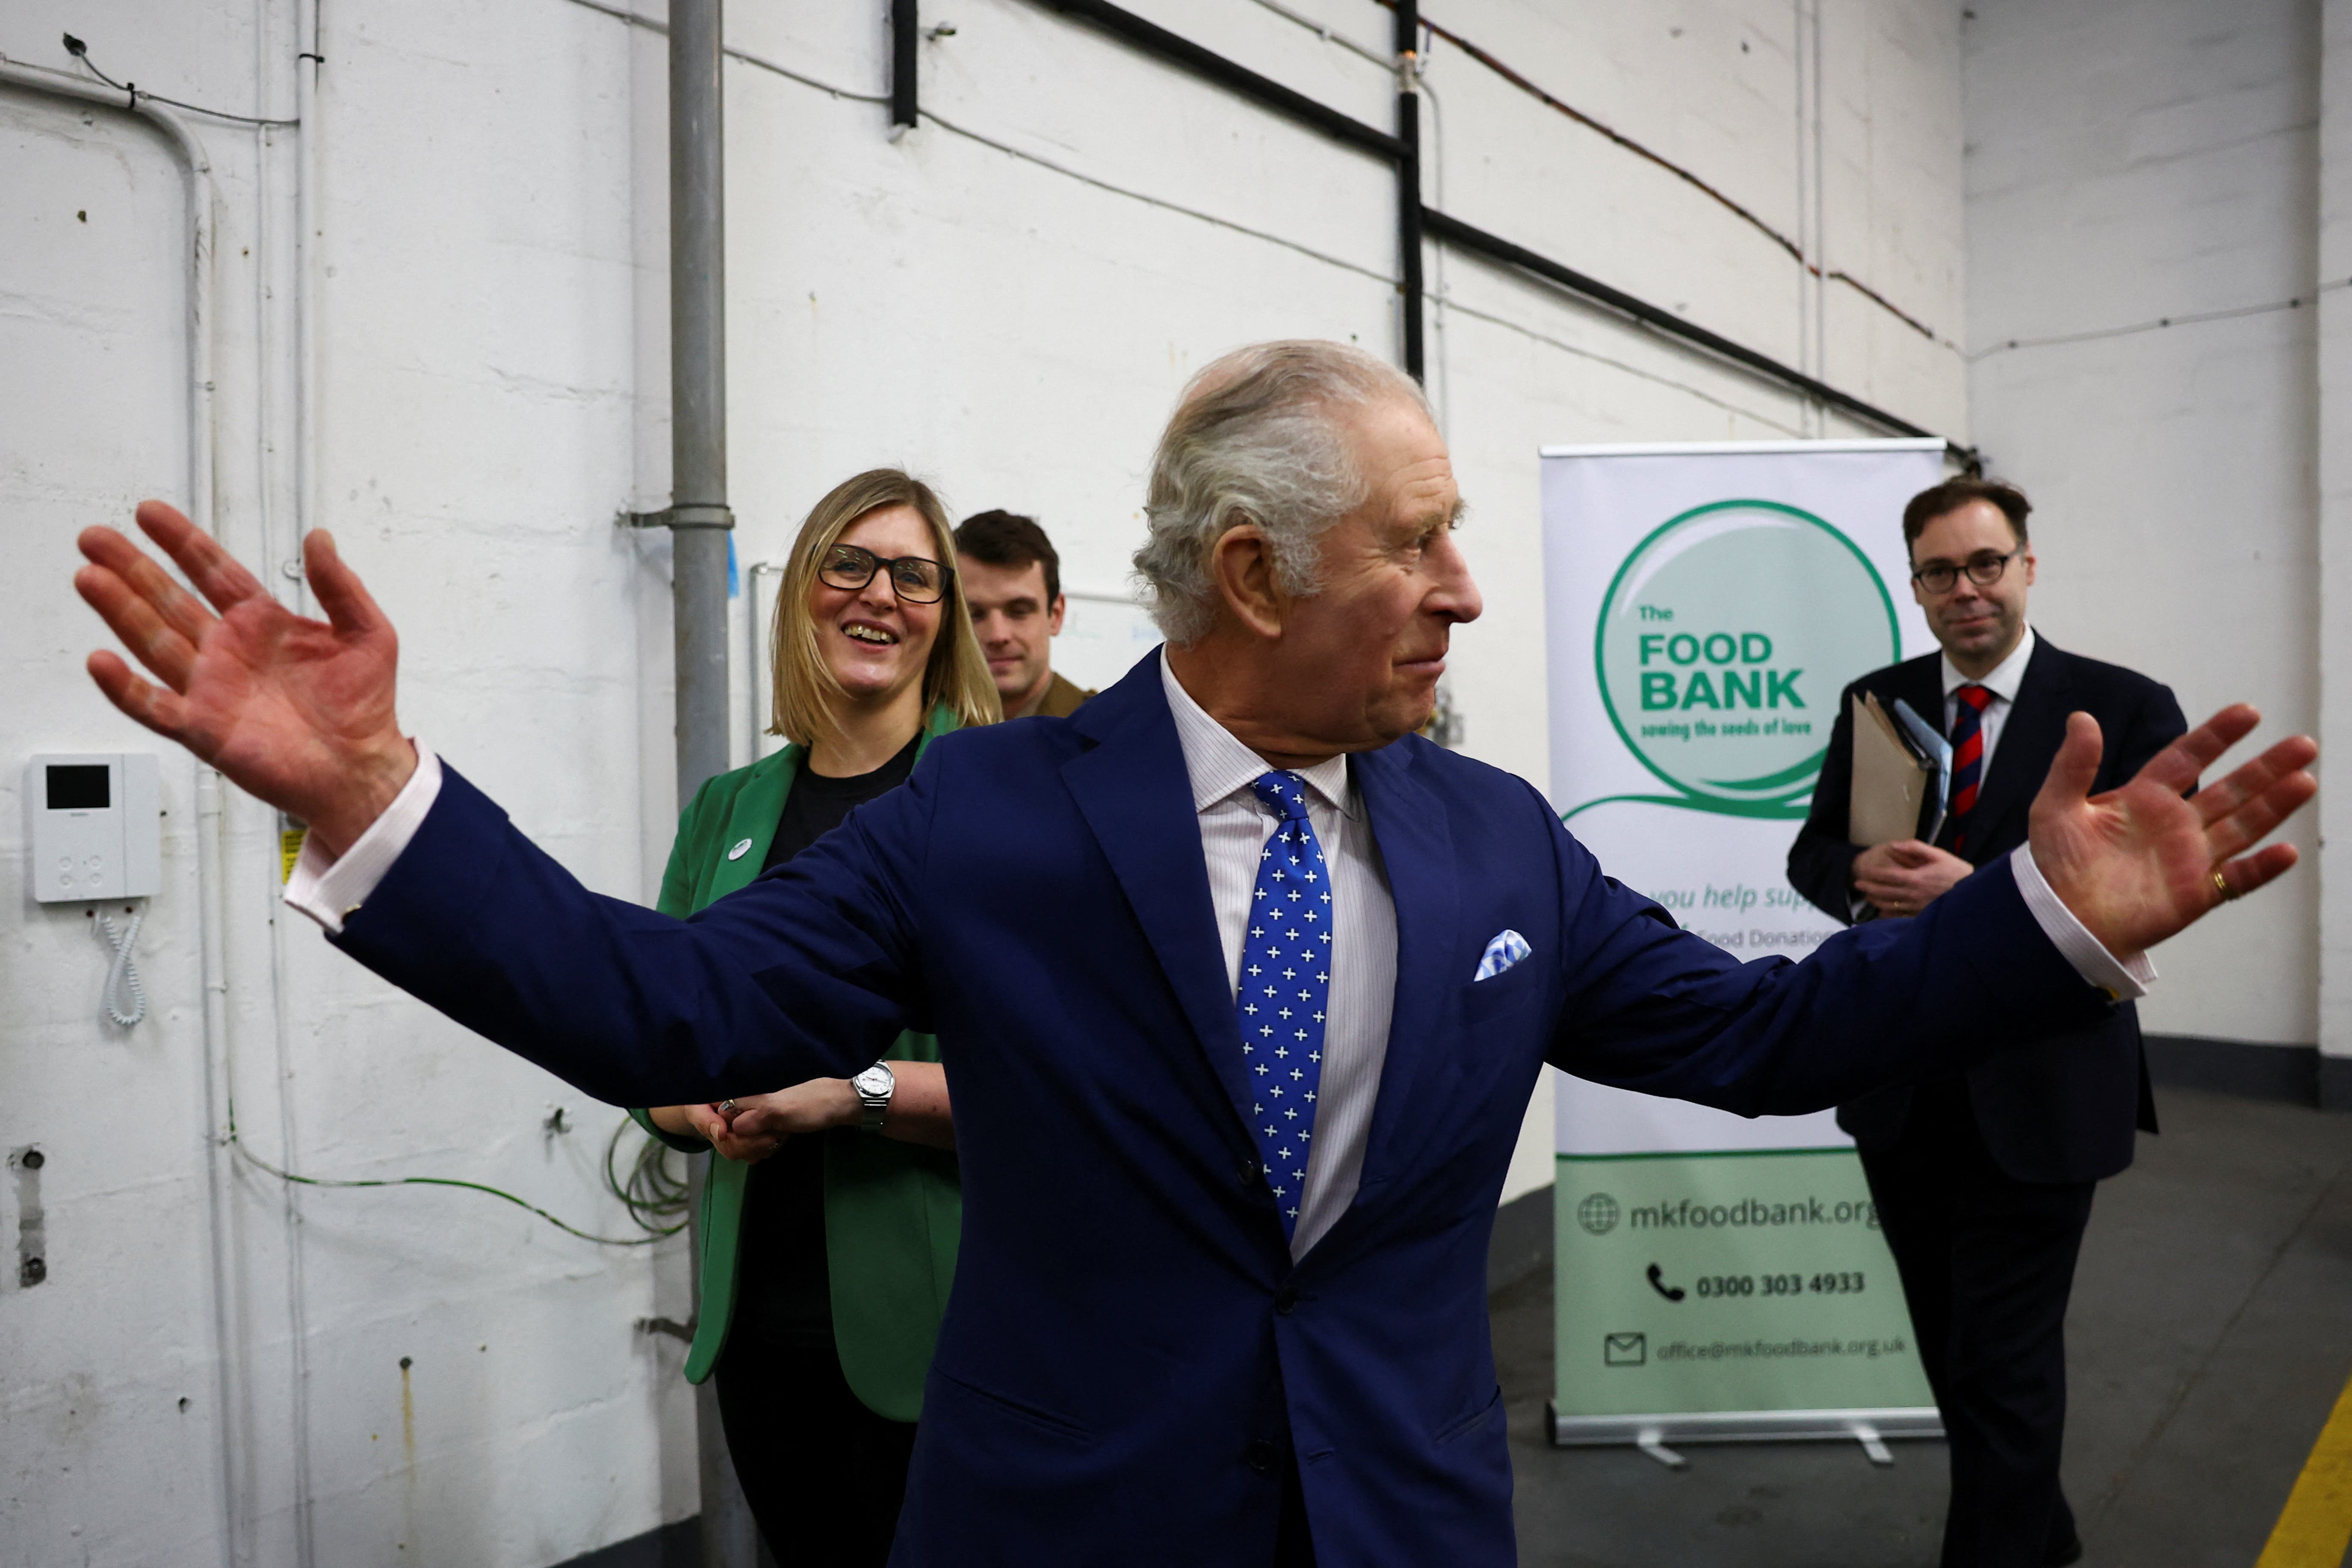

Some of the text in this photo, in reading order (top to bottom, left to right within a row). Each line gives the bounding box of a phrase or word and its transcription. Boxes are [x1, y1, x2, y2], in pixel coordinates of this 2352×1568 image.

[1639, 605, 1673, 620] The
[1640, 632, 1772, 665] FOOD
[1640, 668, 1806, 711] BANK
[1641, 717, 1811, 742] sowing the seeds of love
[1649, 883, 1815, 913] you help sup
[1696, 1272, 1865, 1298] 0300 303 4933
[1657, 1336, 1905, 1361] office@mkfoodbank.org.uk
